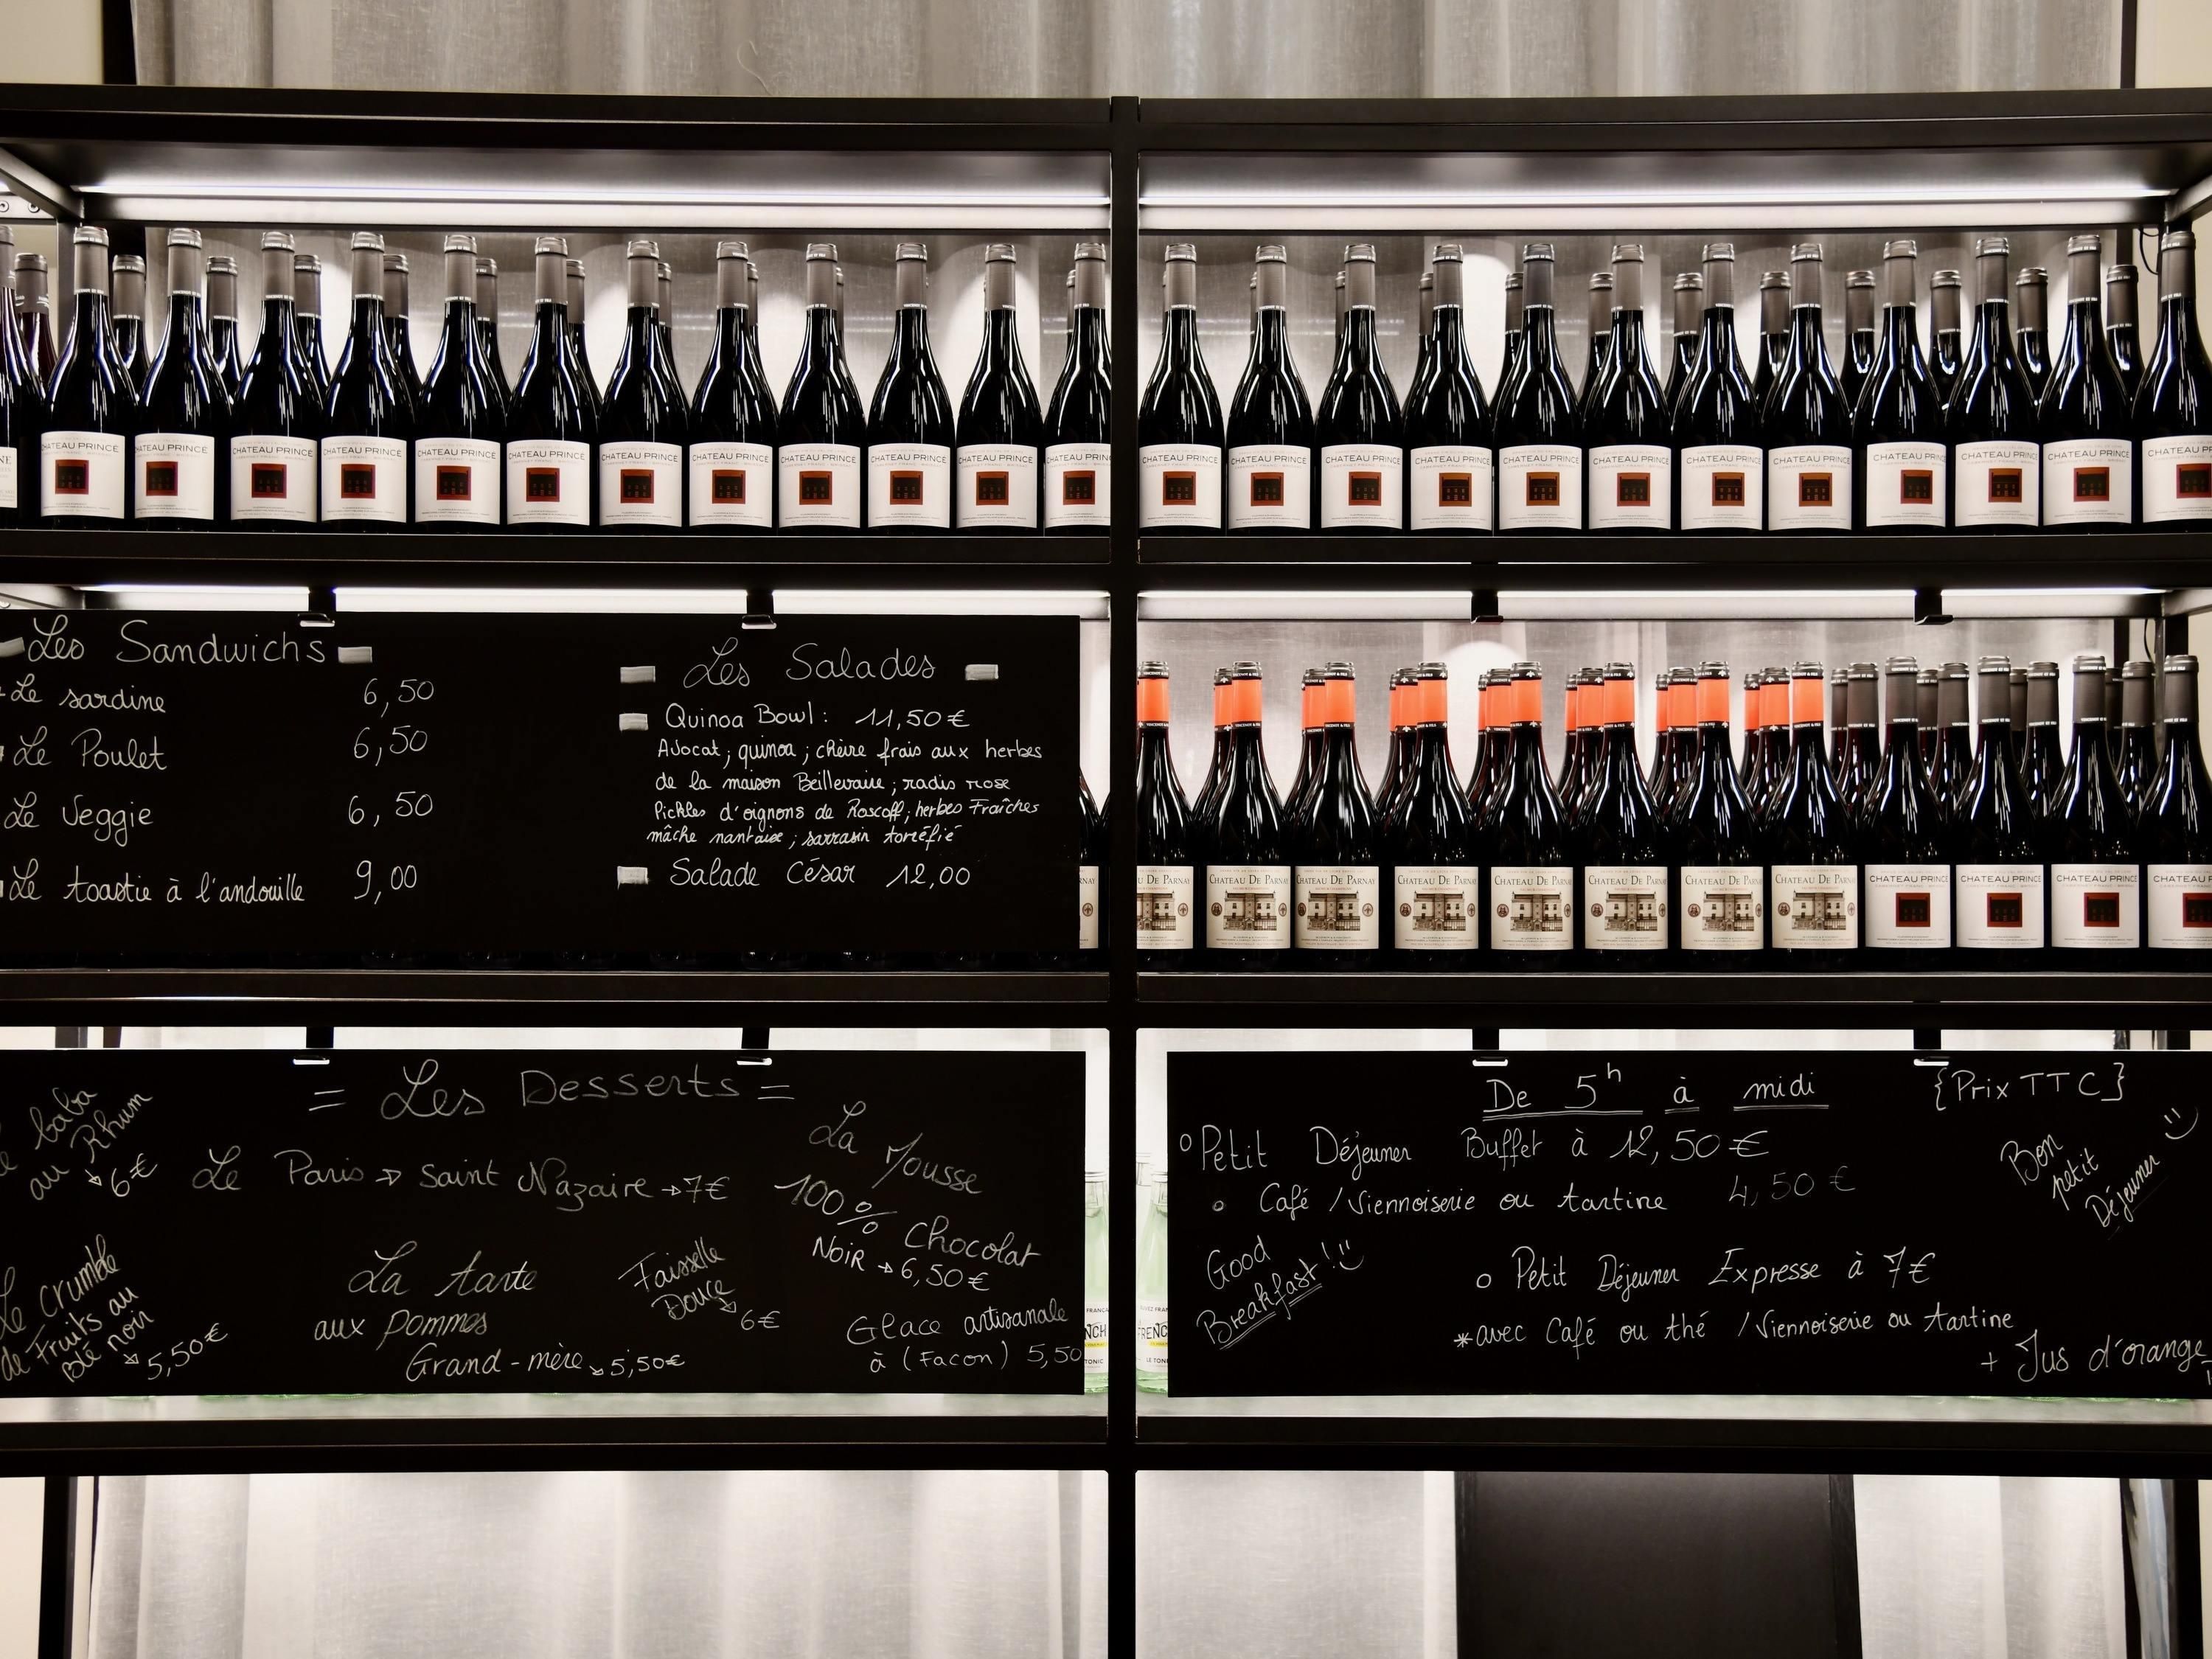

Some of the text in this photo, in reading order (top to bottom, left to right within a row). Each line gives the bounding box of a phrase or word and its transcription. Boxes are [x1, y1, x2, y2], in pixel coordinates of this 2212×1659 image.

[232, 446, 274, 455] CHATEAU
[508, 451, 547, 460] CHATEAU
[692, 453, 733, 462] CHATEAU
[781, 454, 820, 463] CHATEAU
[1142, 454, 1183, 464] CHATEAU
[1593, 456, 1638, 465] CHATEAU
[27, 613, 327, 664] Les Sandwichs
[683, 636, 936, 689] Les Salades
[10, 672, 167, 714] Le sardine
[364, 678, 434, 718] 6,50
[665, 702, 744, 728] Quinoa
[13, 726, 167, 771] Le Poulet
[353, 725, 428, 767] 6,50
[877, 737, 922, 767] frais
[931, 745, 969, 759] aux
[985, 740, 1043, 759] herbes
[655, 771, 678, 791] de
[689, 770, 712, 791] la
[722, 770, 781, 791] maison
[902, 775, 956, 791] radis
[965, 779, 1011, 790] rose
[4, 791, 153, 847] Le Veggie
[654, 801, 706, 821] Pickles
[815, 803, 834, 821] de
[915, 799, 963, 818] herbes
[646, 824, 698, 844] mâche
[801, 827, 871, 848] sarrasin
[9, 858, 42, 901] Le
[64, 865, 153, 903] toastie
[166, 877, 183, 903] à
[354, 860, 417, 905] 9,00
[669, 857, 970, 889] Salade César 12,00
[1209, 874, 1245, 884] CHATEAU
[1296, 874, 1327, 884] CHATEAU
[380, 1058, 740, 1120] Les Desserts
[1486, 1079, 1531, 1110] De
[1673, 1076, 1695, 1104] à
[1742, 1071, 1815, 1100] midi
[29, 1087, 100, 1152] baba
[29, 1091, 153, 1200] au Rhum
[810, 1101, 981, 1194] La Mousse
[1202, 1124, 1267, 1172] Petit
[1309, 1125, 1413, 1181] Déjeuner
[1460, 1127, 1543, 1172] Buffet
[1571, 1128, 1588, 1157] à
[2000, 1133, 2065, 1187] Bon
[111, 1152, 158, 1197] 6€
[192, 1145, 730, 1211] Le Paris Saint Nazaire 7€
[2051, 1147, 2100, 1212] petit
[2084, 1153, 2160, 1228] Déjeuner
[773, 1172, 1040, 1268] 100% Chocolat
[1259, 1182, 1310, 1221] Café
[1499, 1194, 1534, 1211] ou
[1557, 1182, 1668, 1212] tartine
[348, 1240, 535, 1297] La tarte
[617, 1237, 728, 1294] Faisselle
[1207, 1234, 1271, 1293] Good
[1511, 1245, 1935, 1303] Petit Déjeuner Expresse à 7€
[0, 1266, 26, 1340] Le
[650, 1277, 781, 1331] Douce 6€
[846, 1312, 941, 1345] Glace
[964, 1298, 1068, 1335] artisanale
[1, 1287, 141, 1381] de Fruits au
[107, 1307, 154, 1352] noir
[314, 1318, 366, 1341] aux
[1138, 1321, 1168, 1339] FRENC
[1545, 1316, 1596, 1360] Café
[1619, 1324, 1649, 1343] ou
[1663, 1310, 1709, 1341] thé
[1888, 1312, 1912, 1328] ou
[1924, 1301, 2014, 1332] tartine
[869, 1351, 886, 1373] à
[2014, 1329, 2069, 1382] Jus
